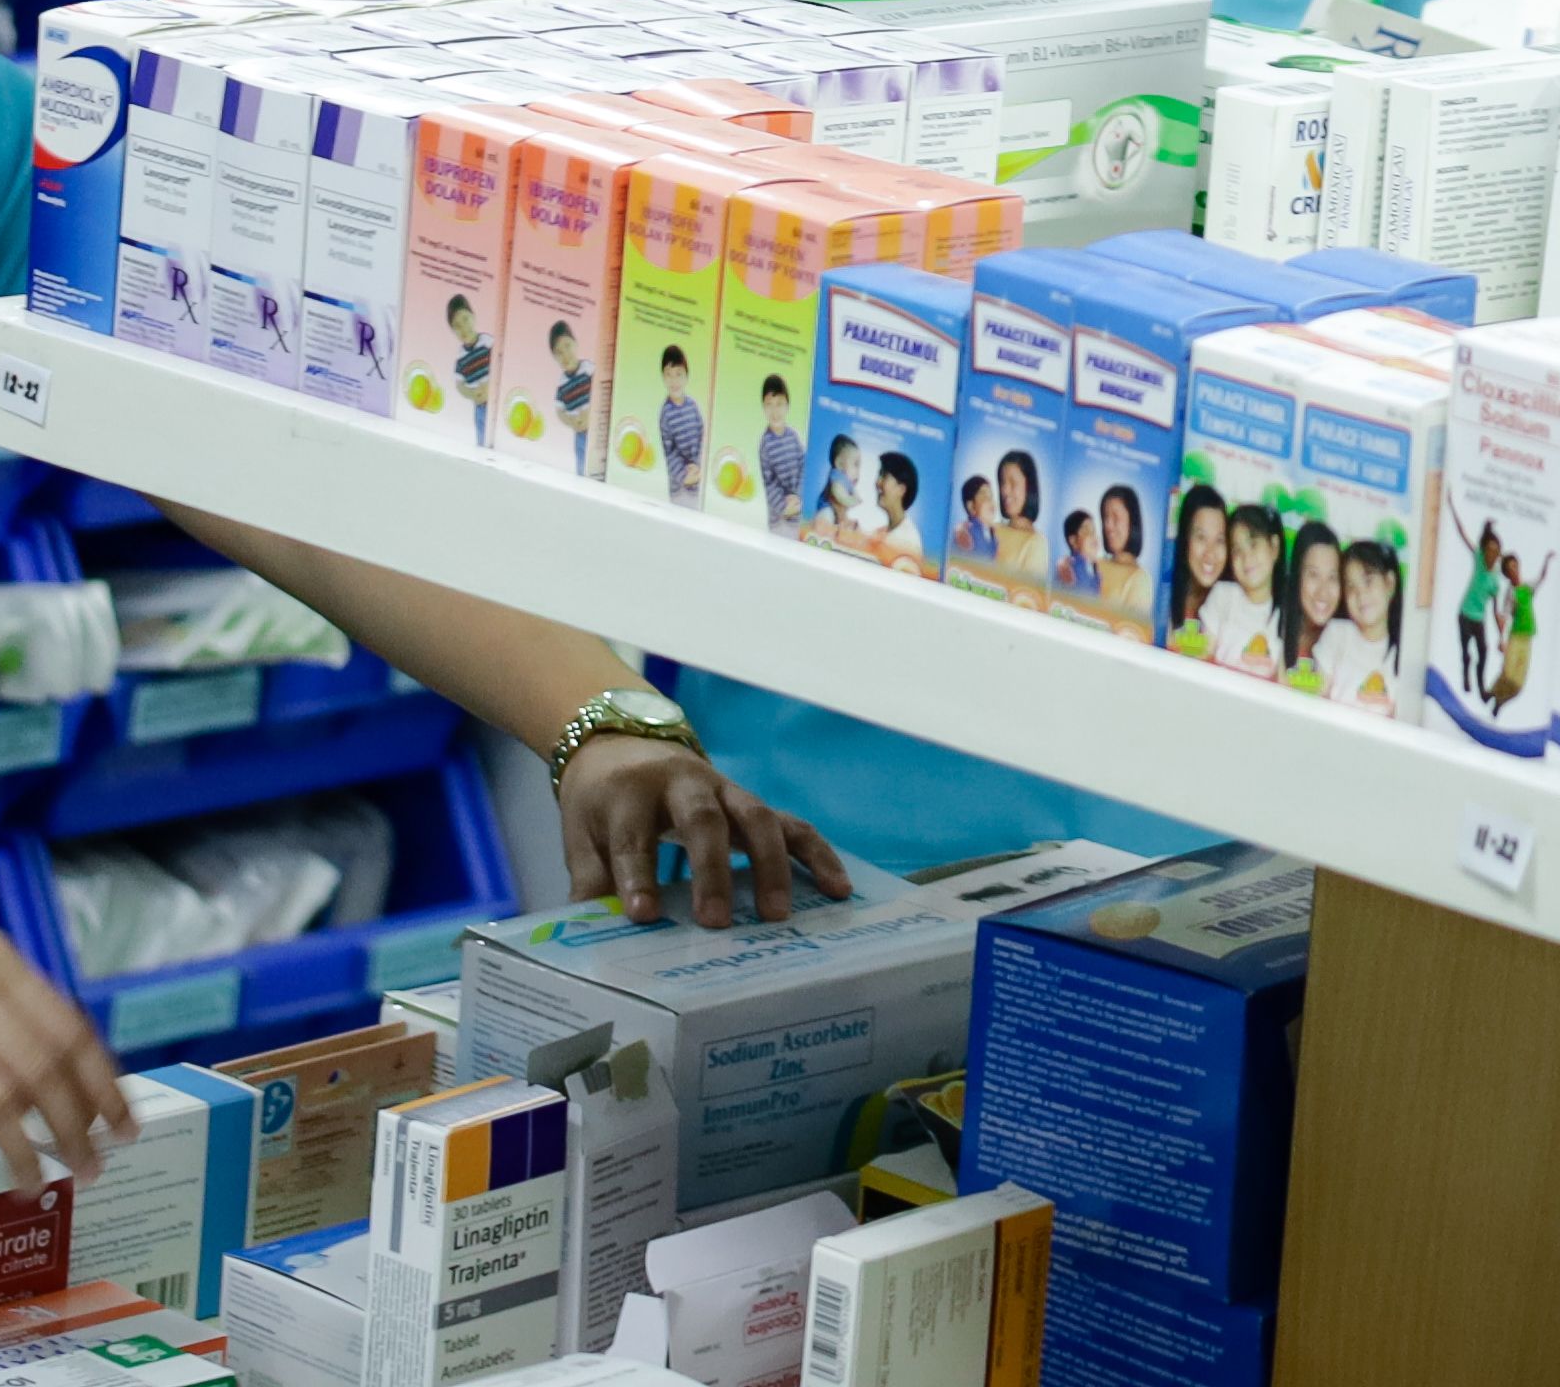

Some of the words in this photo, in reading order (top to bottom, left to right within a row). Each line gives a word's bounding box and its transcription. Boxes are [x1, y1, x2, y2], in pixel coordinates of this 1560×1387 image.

[424, 157, 495, 191] IBUPROFEN
[426, 180, 467, 206] DOLAN
[530, 182, 599, 215] IBUPROFEN
[531, 205, 570, 229] DOLAN
[843, 321, 939, 363] PARACETAMOL
[984, 320, 1061, 354] PARACETAMOL
[860, 354, 918, 385] BIOGESIC
[1086, 352, 1164, 387] PARACETAMOL
[1480, 402, 1551, 439] Sodium
[1479, 435, 1544, 471] Pannox
[824, 910, 946, 941] Sodium
[654, 939, 820, 979] Ascorbate
[708, 1036, 774, 1068] Sodium
[781, 1019, 869, 1051] Ascorbate
[770, 1058, 805, 1080] Zinc
[703, 1089, 800, 1121] ImmunPro
[421, 1143, 440, 1226] Linagliptin
[452, 1205, 468, 1221] 30
[471, 1196, 512, 1219] tablets
[453, 1207, 549, 1252] Linagliptin
[1, 1251, 47, 1275] citrate
[444, 1304, 455, 1320] 5
[457, 1298, 482, 1318] mg
[444, 1332, 480, 1354] Tablet
[441, 1349, 515, 1381] Antidiabetic
